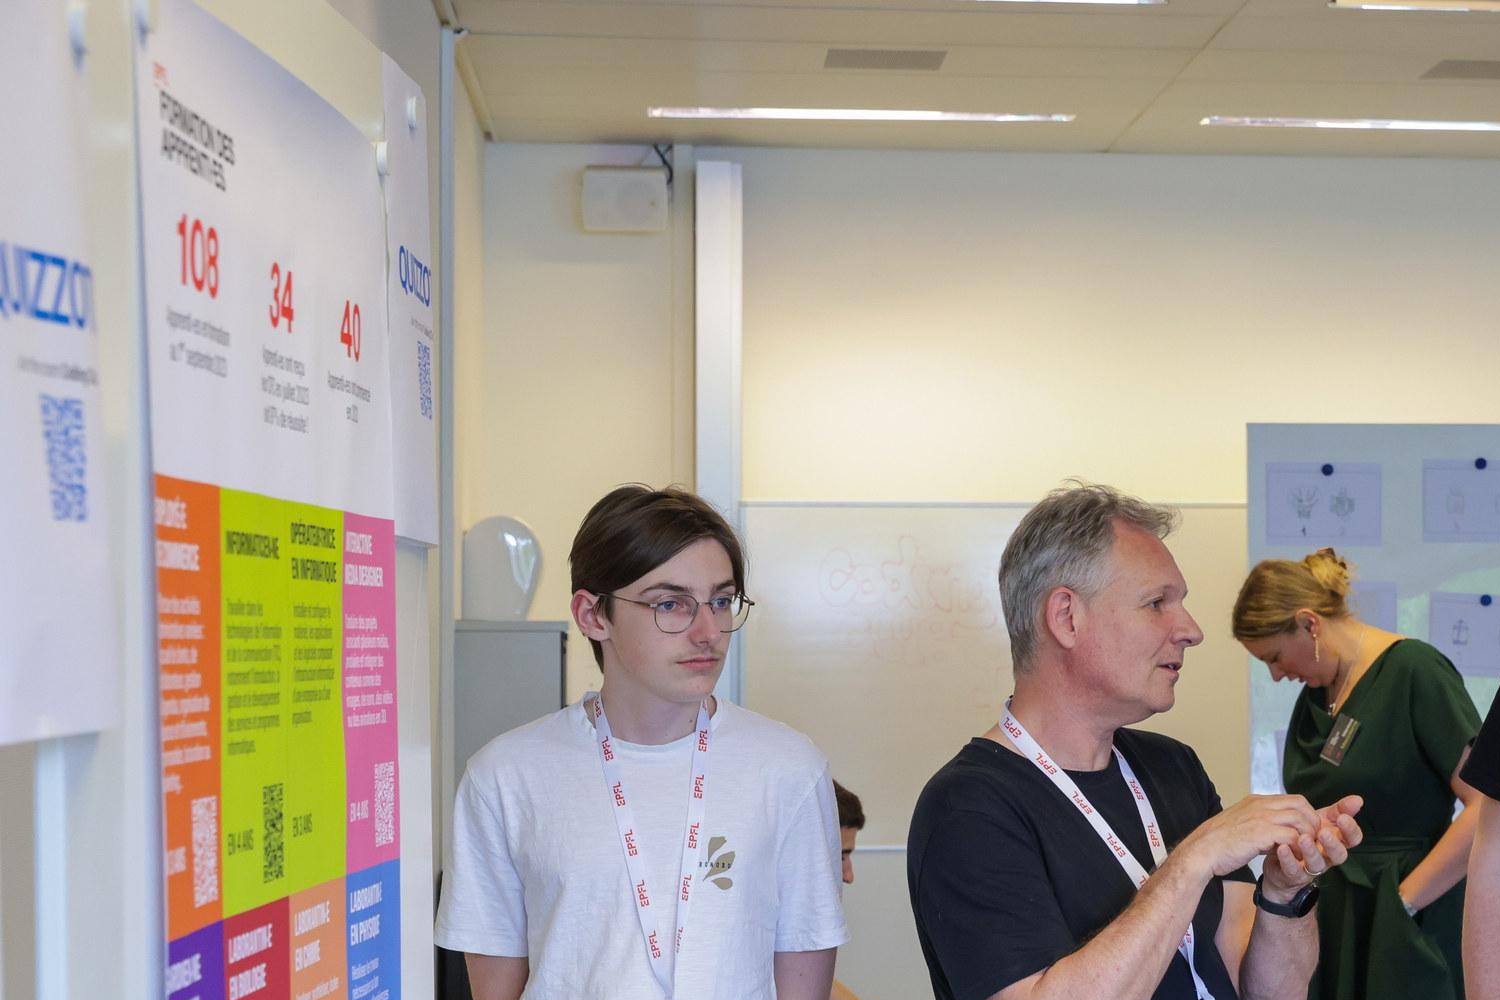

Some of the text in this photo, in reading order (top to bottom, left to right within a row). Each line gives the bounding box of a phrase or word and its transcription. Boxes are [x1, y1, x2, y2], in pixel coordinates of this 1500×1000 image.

[159, 89, 235, 165] FORMATION DES
[177, 214, 219, 299] 108
[270, 262, 294, 333] 34
[340, 300, 360, 362] 40
[698, 728, 708, 752] EPFL
[1003, 716, 1022, 739] EPFL
[602, 735, 614, 762] EPFL
[1035, 752, 1057, 776] EPFL
[613, 780, 625, 807] EPFL
[694, 773, 704, 799] EPFL
[1130, 779, 1144, 801] EPFL
[1072, 791, 1093, 815] EPFL
[624, 828, 638, 857] EPFL
[688, 822, 700, 849] EPFL
[1107, 832, 1126, 858] EPFL
[1147, 822, 1160, 849] EPFL
[636, 879, 650, 908] EPFL
[682, 873, 692, 902] EPFL
[649, 929, 661, 960] EPFL
